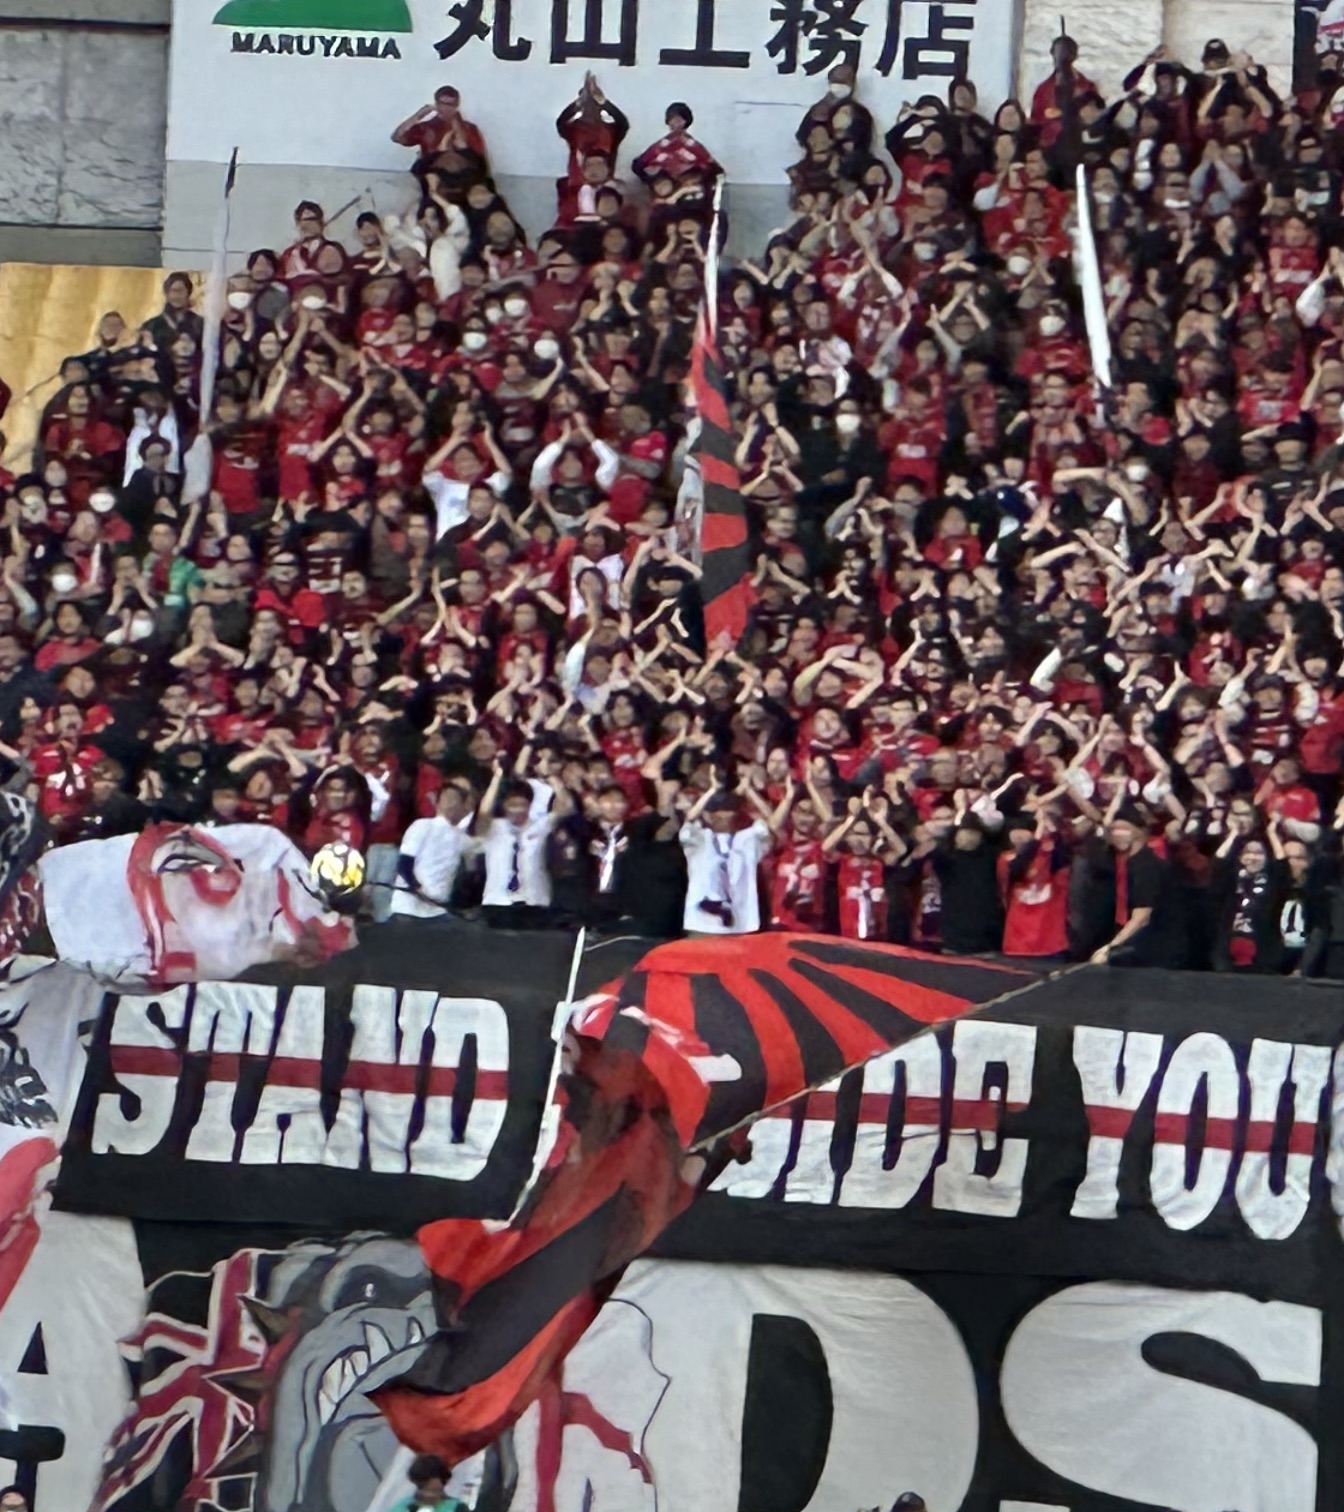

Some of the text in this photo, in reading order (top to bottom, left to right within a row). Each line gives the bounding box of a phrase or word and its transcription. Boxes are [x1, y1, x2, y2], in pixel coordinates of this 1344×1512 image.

[229, 31, 403, 59] MARUYAMA
[432, 0, 977, 81] 丸山工務店
[91, 979, 510, 1182] STAND
[1070, 1025, 1333, 1240] YOU
